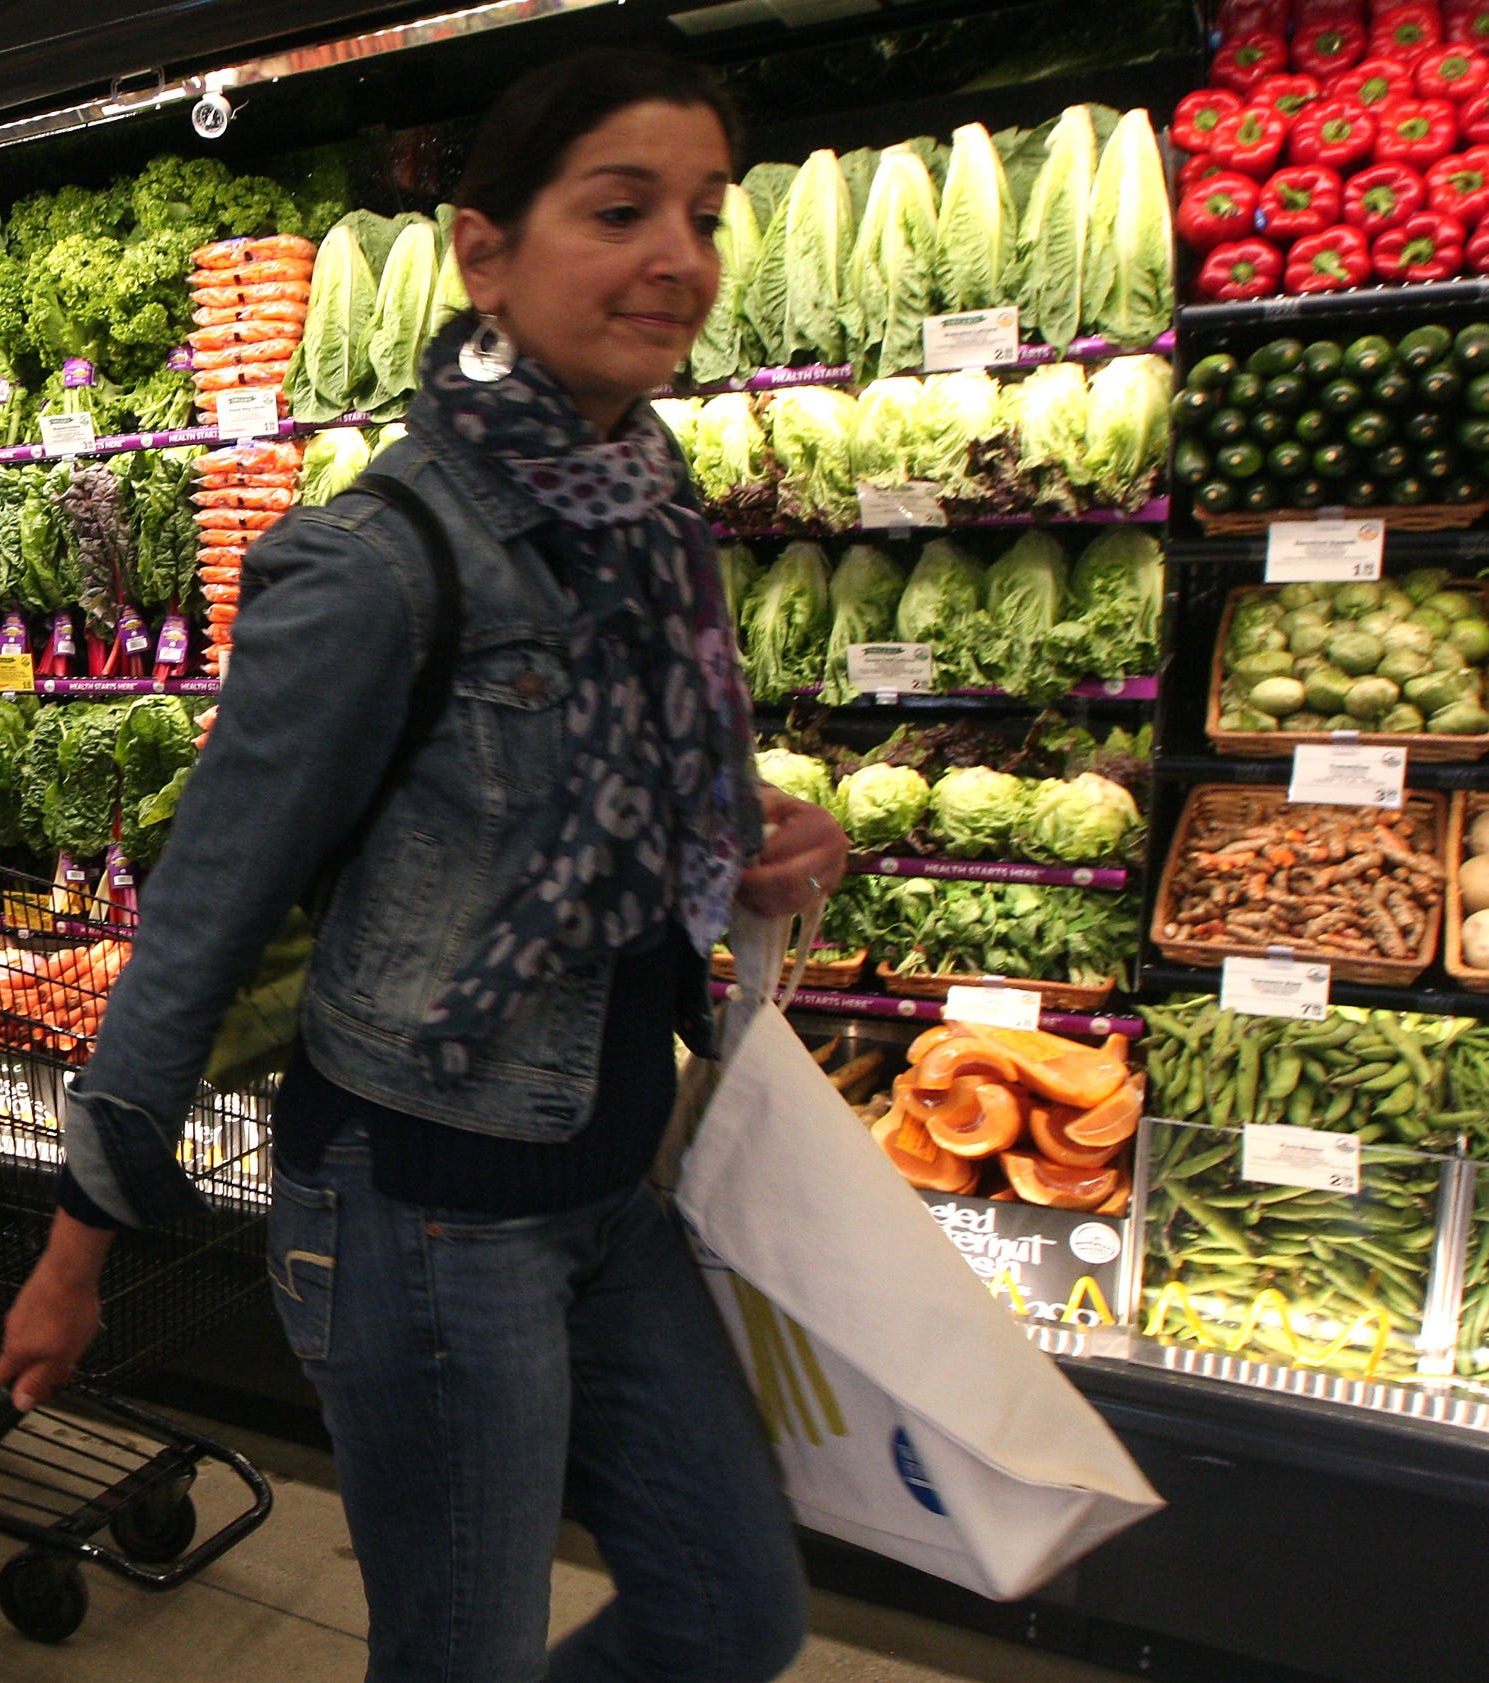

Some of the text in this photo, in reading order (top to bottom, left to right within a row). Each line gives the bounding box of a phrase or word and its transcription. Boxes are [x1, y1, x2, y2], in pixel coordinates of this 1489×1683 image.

[771, 363, 852, 384] HEALTH STARTS
[197, 430, 219, 440] START
[924, 863, 1039, 879] HEALTH STARTS HERE
